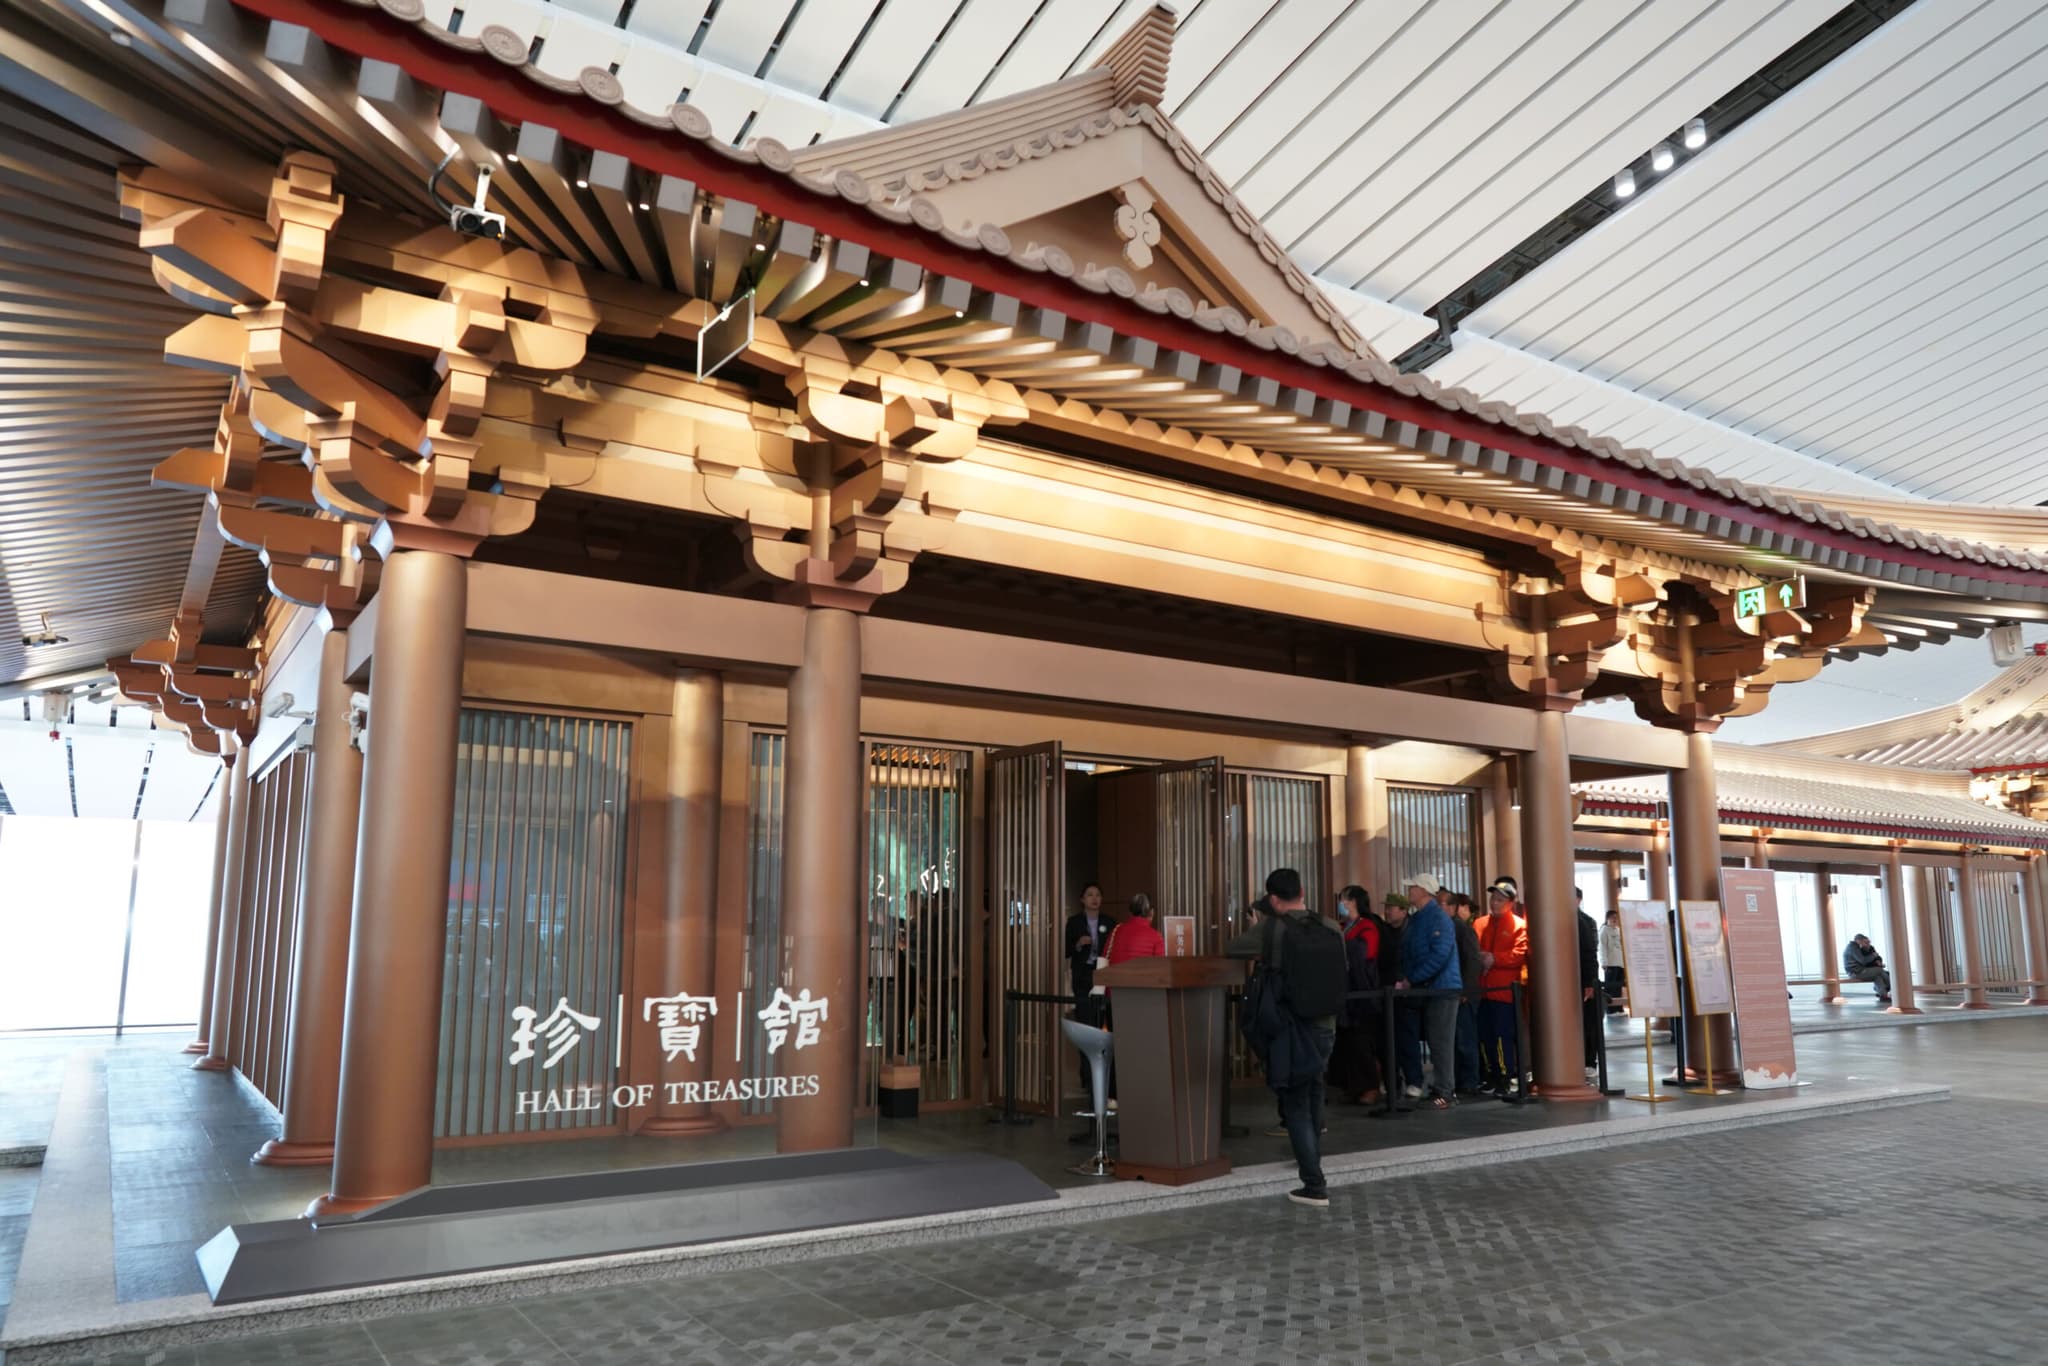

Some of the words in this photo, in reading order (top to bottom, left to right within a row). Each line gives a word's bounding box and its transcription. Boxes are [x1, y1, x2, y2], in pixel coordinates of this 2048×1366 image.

[515, 1088, 600, 1114] HALL
[613, 1083, 654, 1108] OF
[665, 1075, 820, 1105] TREASURES
